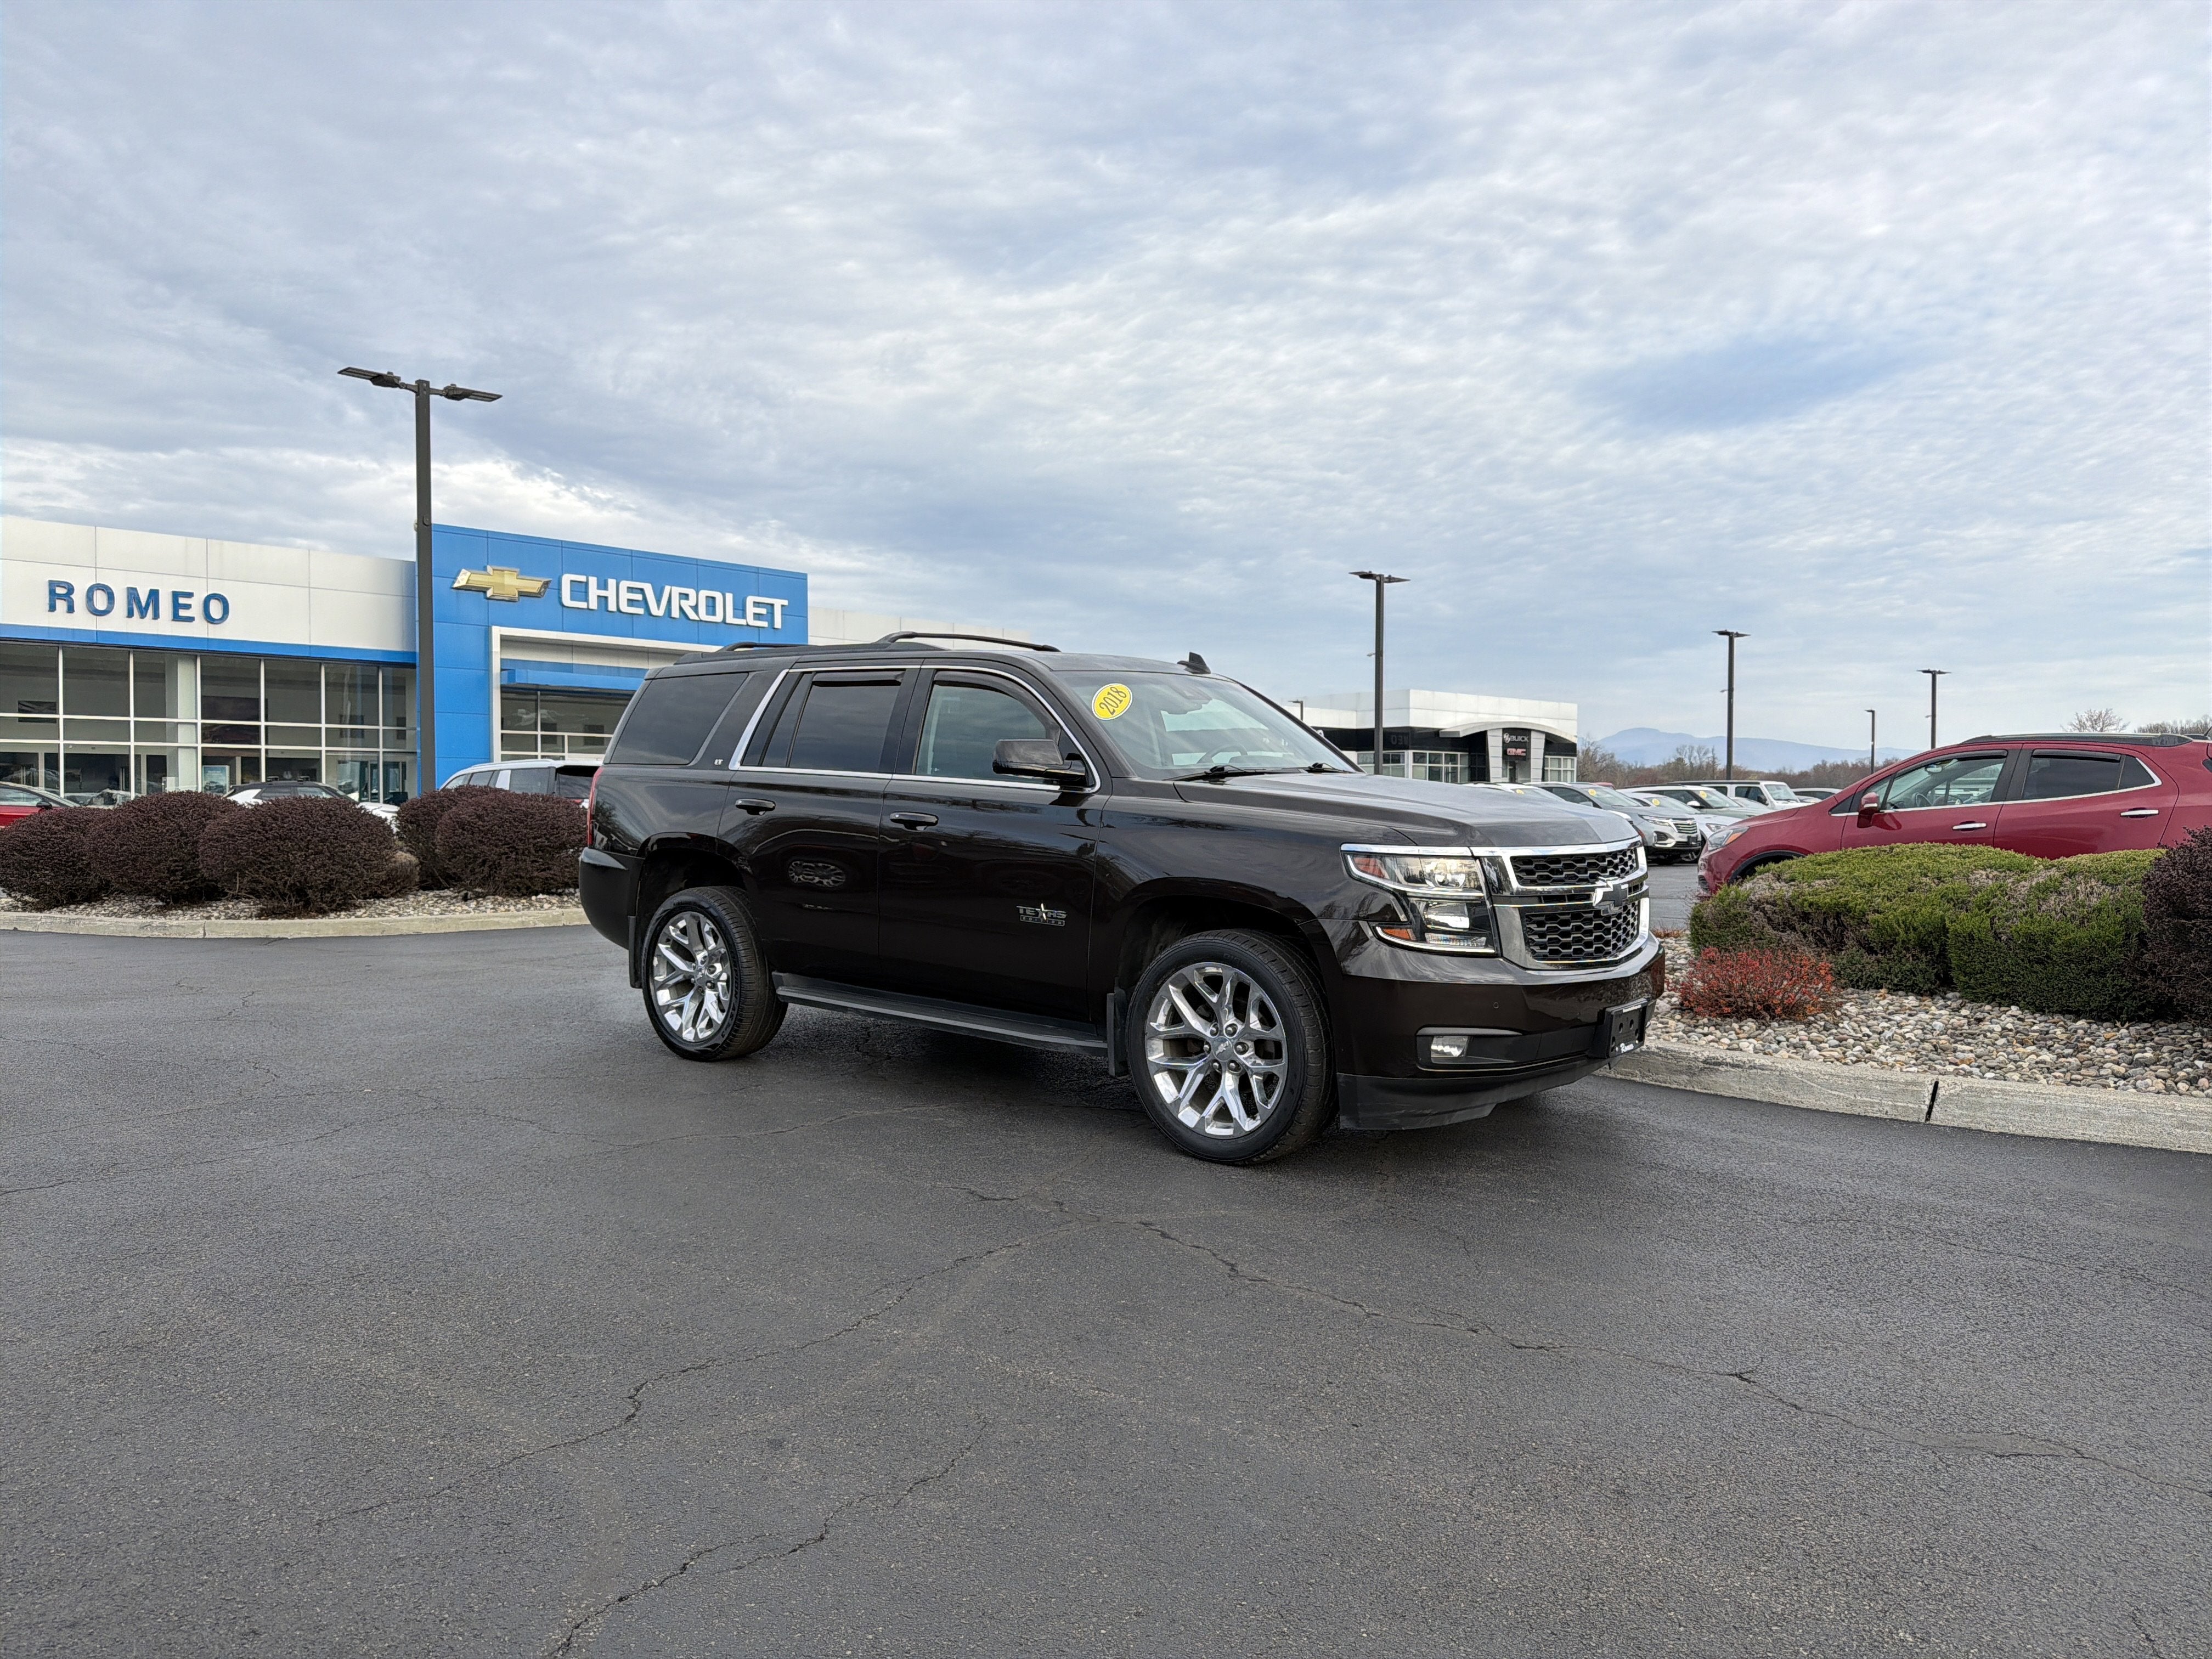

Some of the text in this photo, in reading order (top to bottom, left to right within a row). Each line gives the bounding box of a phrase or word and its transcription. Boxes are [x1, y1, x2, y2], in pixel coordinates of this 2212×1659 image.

[48, 579, 229, 624] ROMEO
[562, 573, 789, 629] CHEVROLET
[1099, 686, 1127, 715] 2018
[1506, 748, 1526, 756] GMC
[1016, 904, 1068, 919] TEXAS
